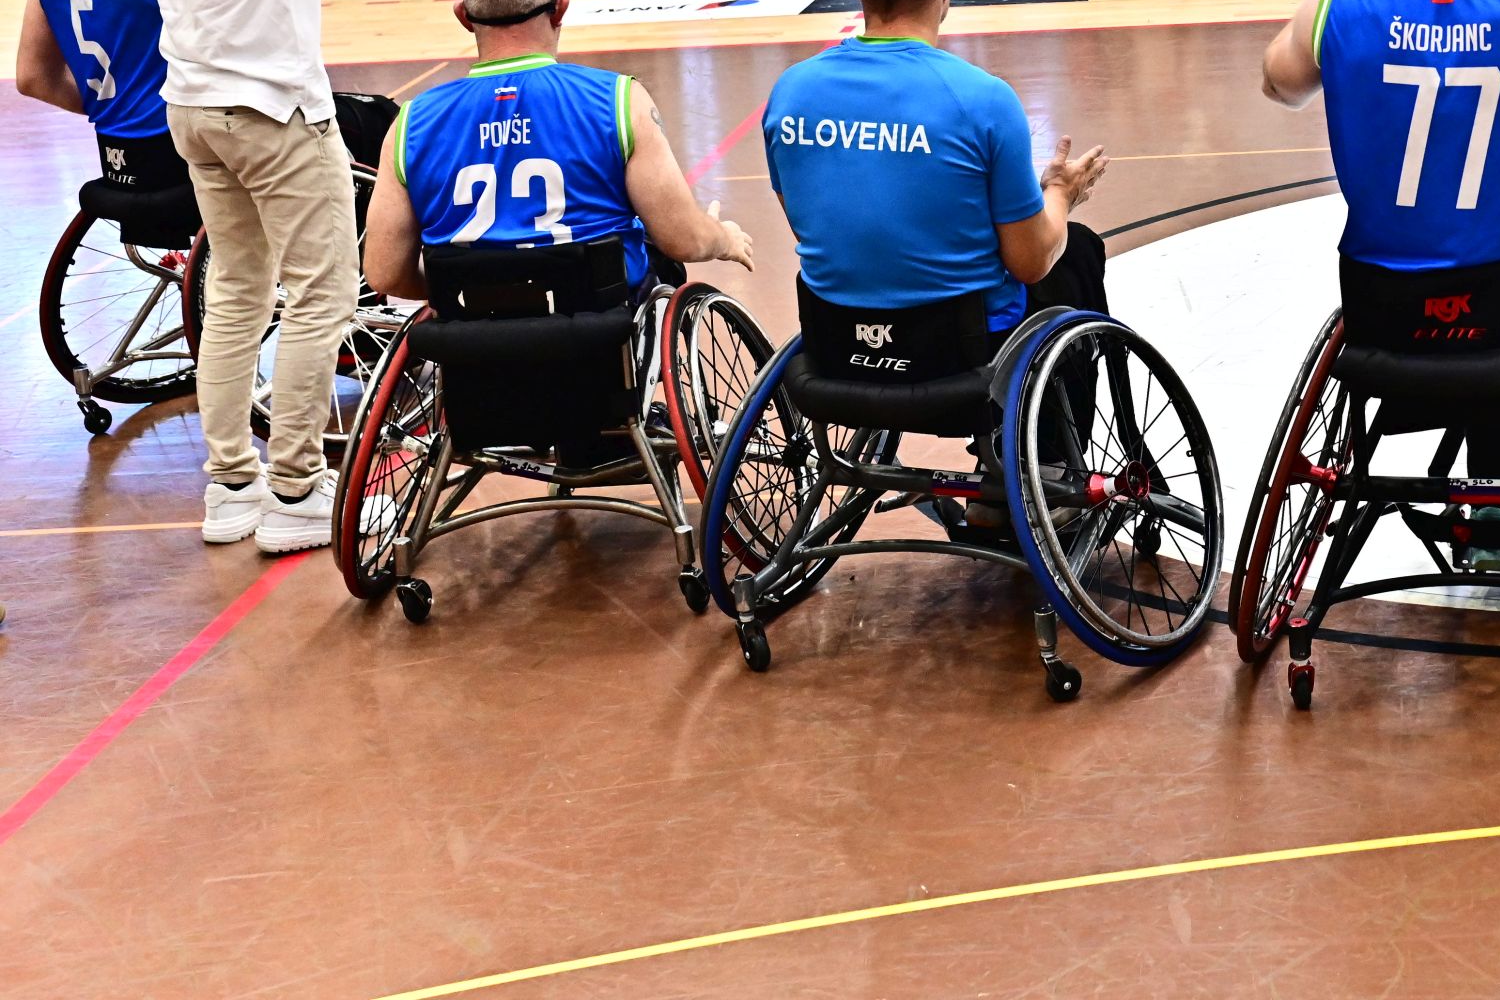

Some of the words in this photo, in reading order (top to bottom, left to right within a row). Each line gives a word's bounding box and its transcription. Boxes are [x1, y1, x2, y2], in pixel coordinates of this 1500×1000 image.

[1388, 16, 1492, 53] ŠKORJANC
[479, 113, 531, 150] POVŠE
[781, 116, 931, 154] SLOVENIA
[107, 171, 136, 185] ELITE
[450, 157, 573, 250] 23
[850, 354, 911, 371] ELITE
